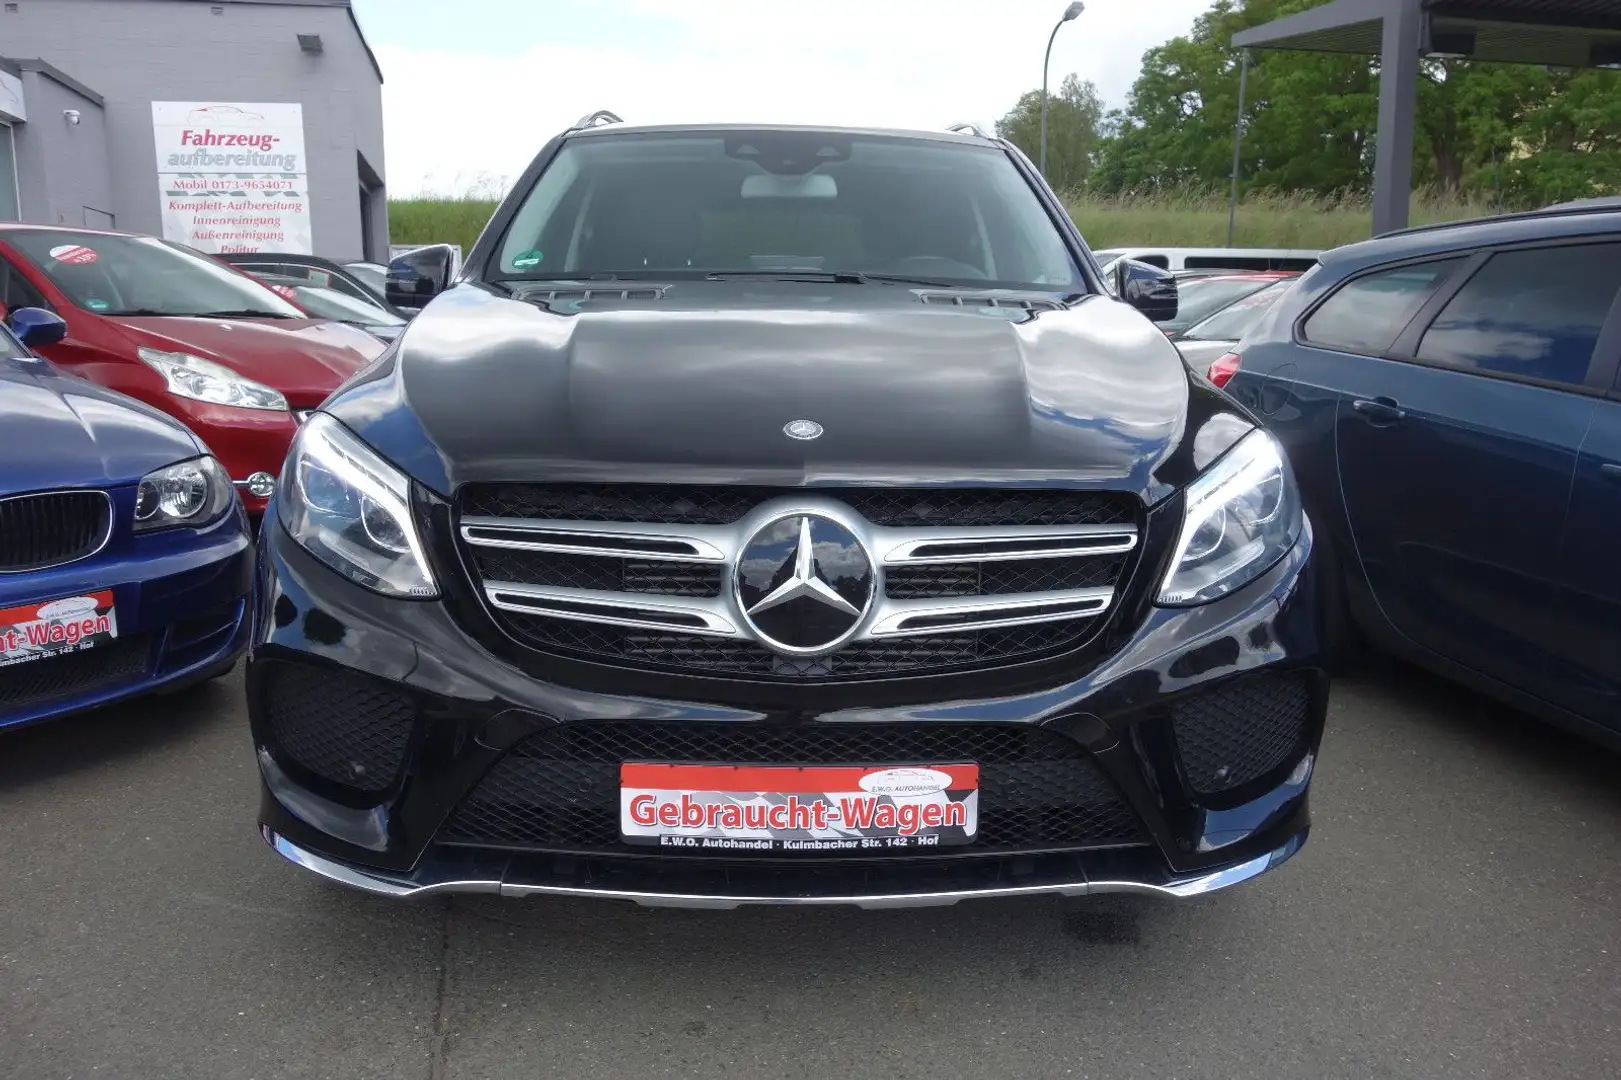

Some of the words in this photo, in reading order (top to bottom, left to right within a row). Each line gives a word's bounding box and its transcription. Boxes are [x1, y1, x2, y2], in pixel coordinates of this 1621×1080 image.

[181, 129, 280, 151] Fahrzeug-
[167, 148, 297, 171] aufbereitung
[173, 180, 207, 189] Mobil
[212, 180, 293, 190] 0173-9654071
[169, 199, 302, 212] Komplett-Aufbereitung
[193, 215, 281, 226] Innenreinigung
[192, 229, 284, 242] Außenreinigung
[220, 243, 260, 254] Politur
[59, 646, 74, 655] 142
[80, 641, 94, 650] Hof
[894, 784, 941, 792] AUTOHANDEL
[629, 794, 967, 835] Gebraucht-Wagen
[660, 837, 699, 847] E.W.O.
[702, 838, 773, 849] Autohandel
[783, 839, 858, 849] Kulmbacher
[861, 839, 882, 848] Str.
[886, 837, 908, 847] 142
[918, 836, 939, 846] Hof
